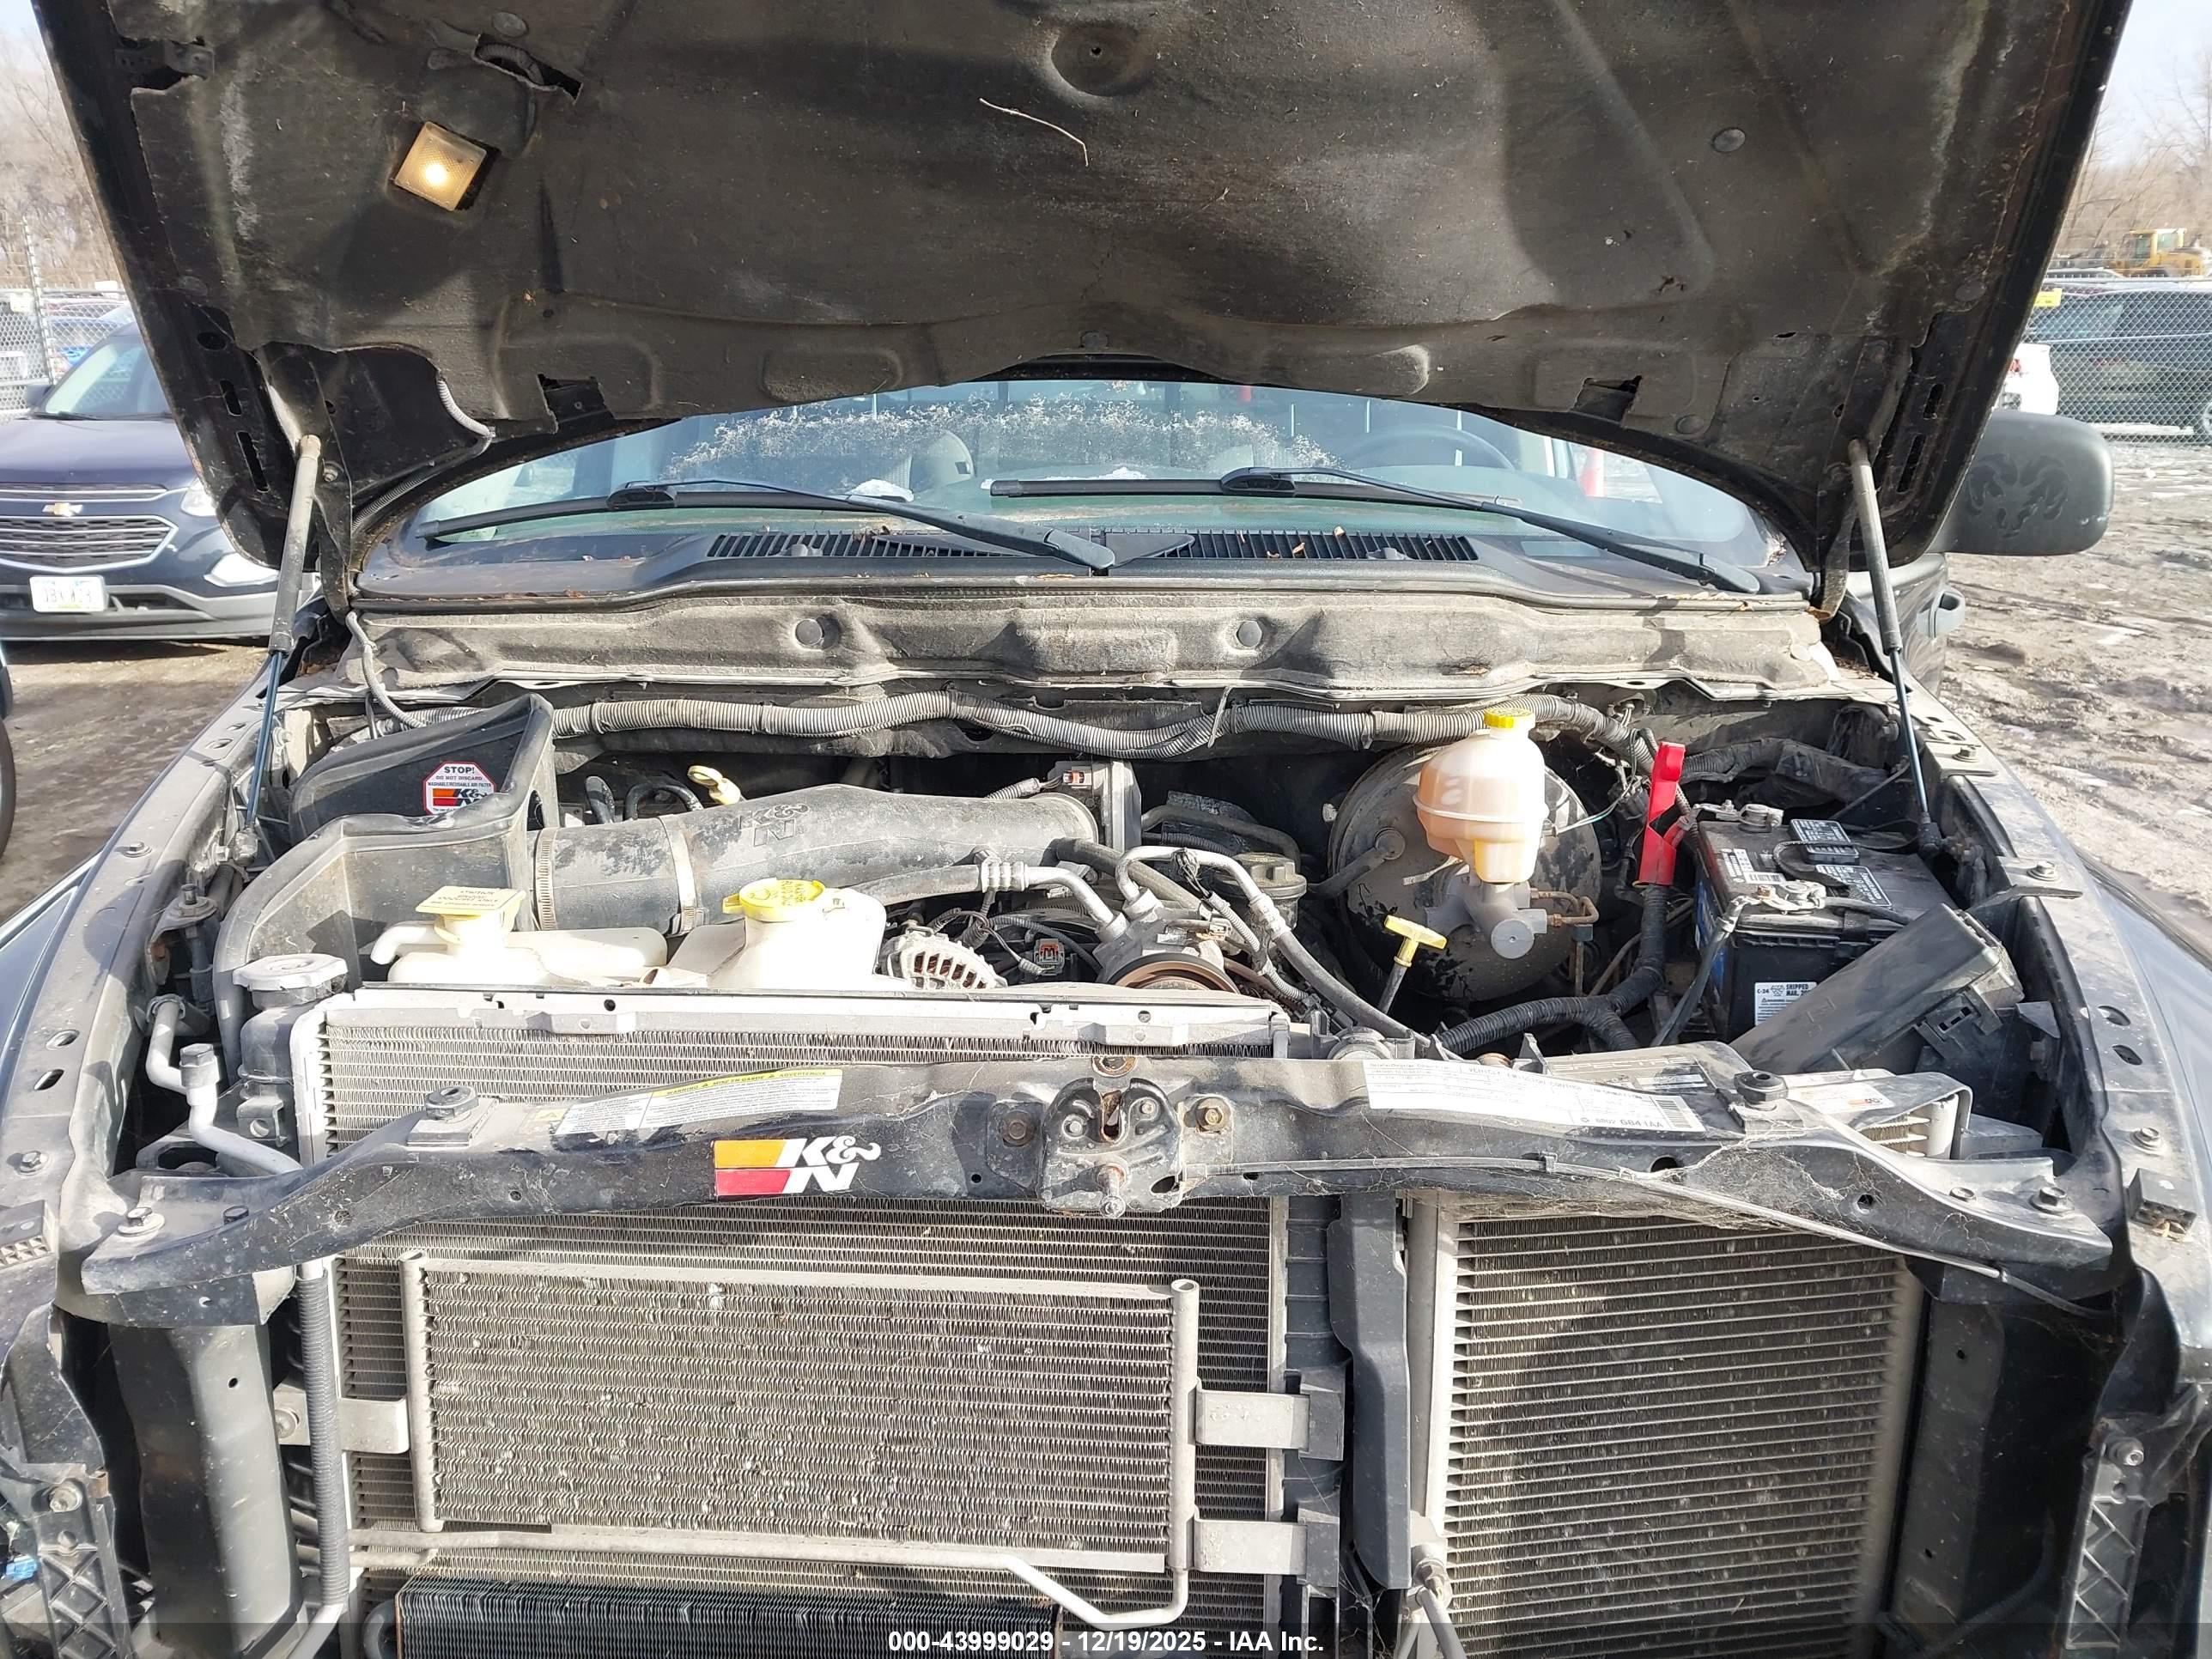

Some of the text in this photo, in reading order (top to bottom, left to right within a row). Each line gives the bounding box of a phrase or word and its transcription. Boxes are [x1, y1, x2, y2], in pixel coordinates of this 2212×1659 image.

[443, 766, 475, 775] STOP!
[1553, 1056, 1692, 1071] SPECTRE
[666, 1085, 699, 1096] WARNING
[775, 1135, 881, 1194] K&N
